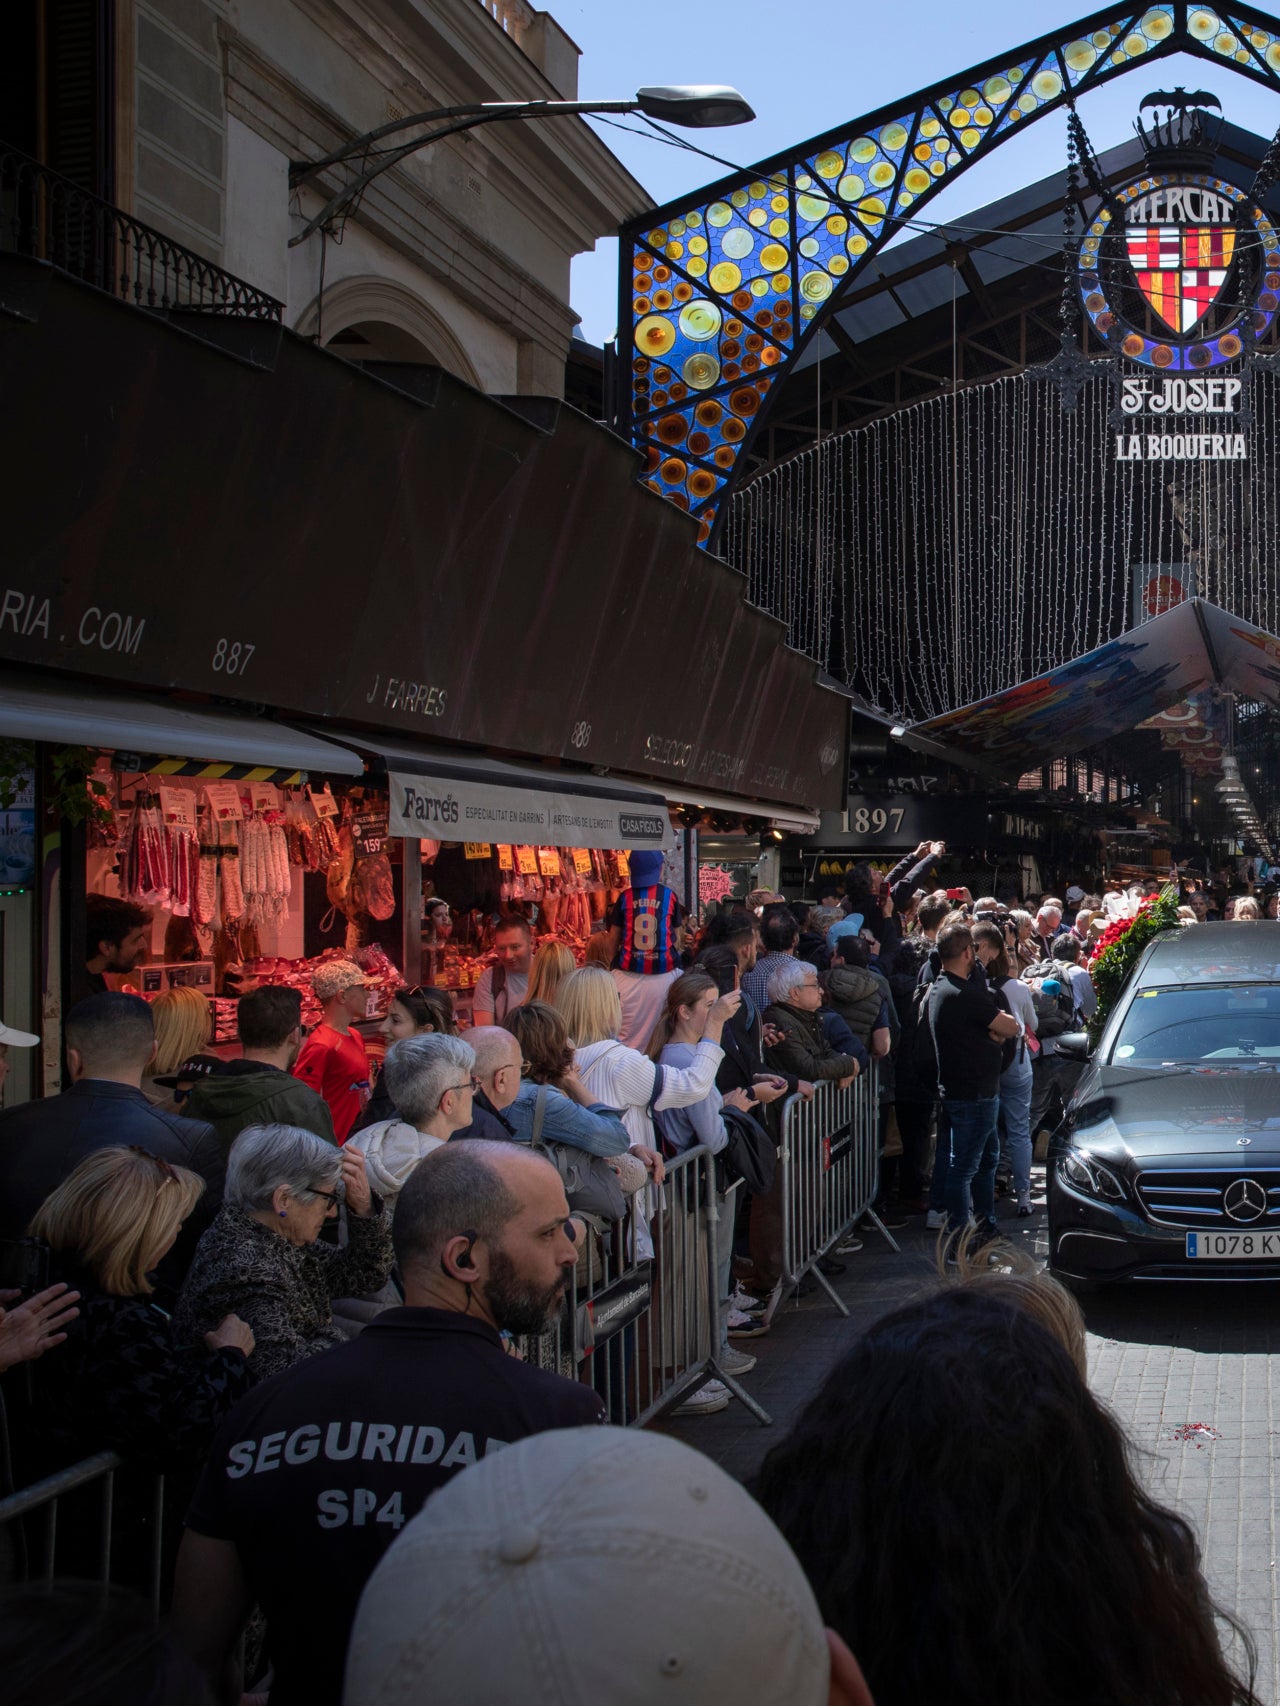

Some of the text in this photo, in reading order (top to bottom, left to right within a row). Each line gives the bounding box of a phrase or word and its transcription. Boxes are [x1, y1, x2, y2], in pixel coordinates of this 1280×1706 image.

[1129, 187, 1234, 224] MERCAT
[1149, 379, 1242, 413] JOSEP
[1116, 434, 1247, 461] LA BOQUERIA
[79, 607, 145, 655] COM
[211, 638, 256, 676] 887
[384, 678, 448, 717] FARRES
[571, 721, 592, 748] 888
[621, 818, 640, 832] CASA
[839, 807, 905, 834] 1897
[364, 838, 381, 853] 159
[633, 898, 661, 909] PEDRI
[634, 913, 658, 951] 8
[1204, 1235, 1254, 1255] 1078
[316, 1487, 406, 1531] SP4
